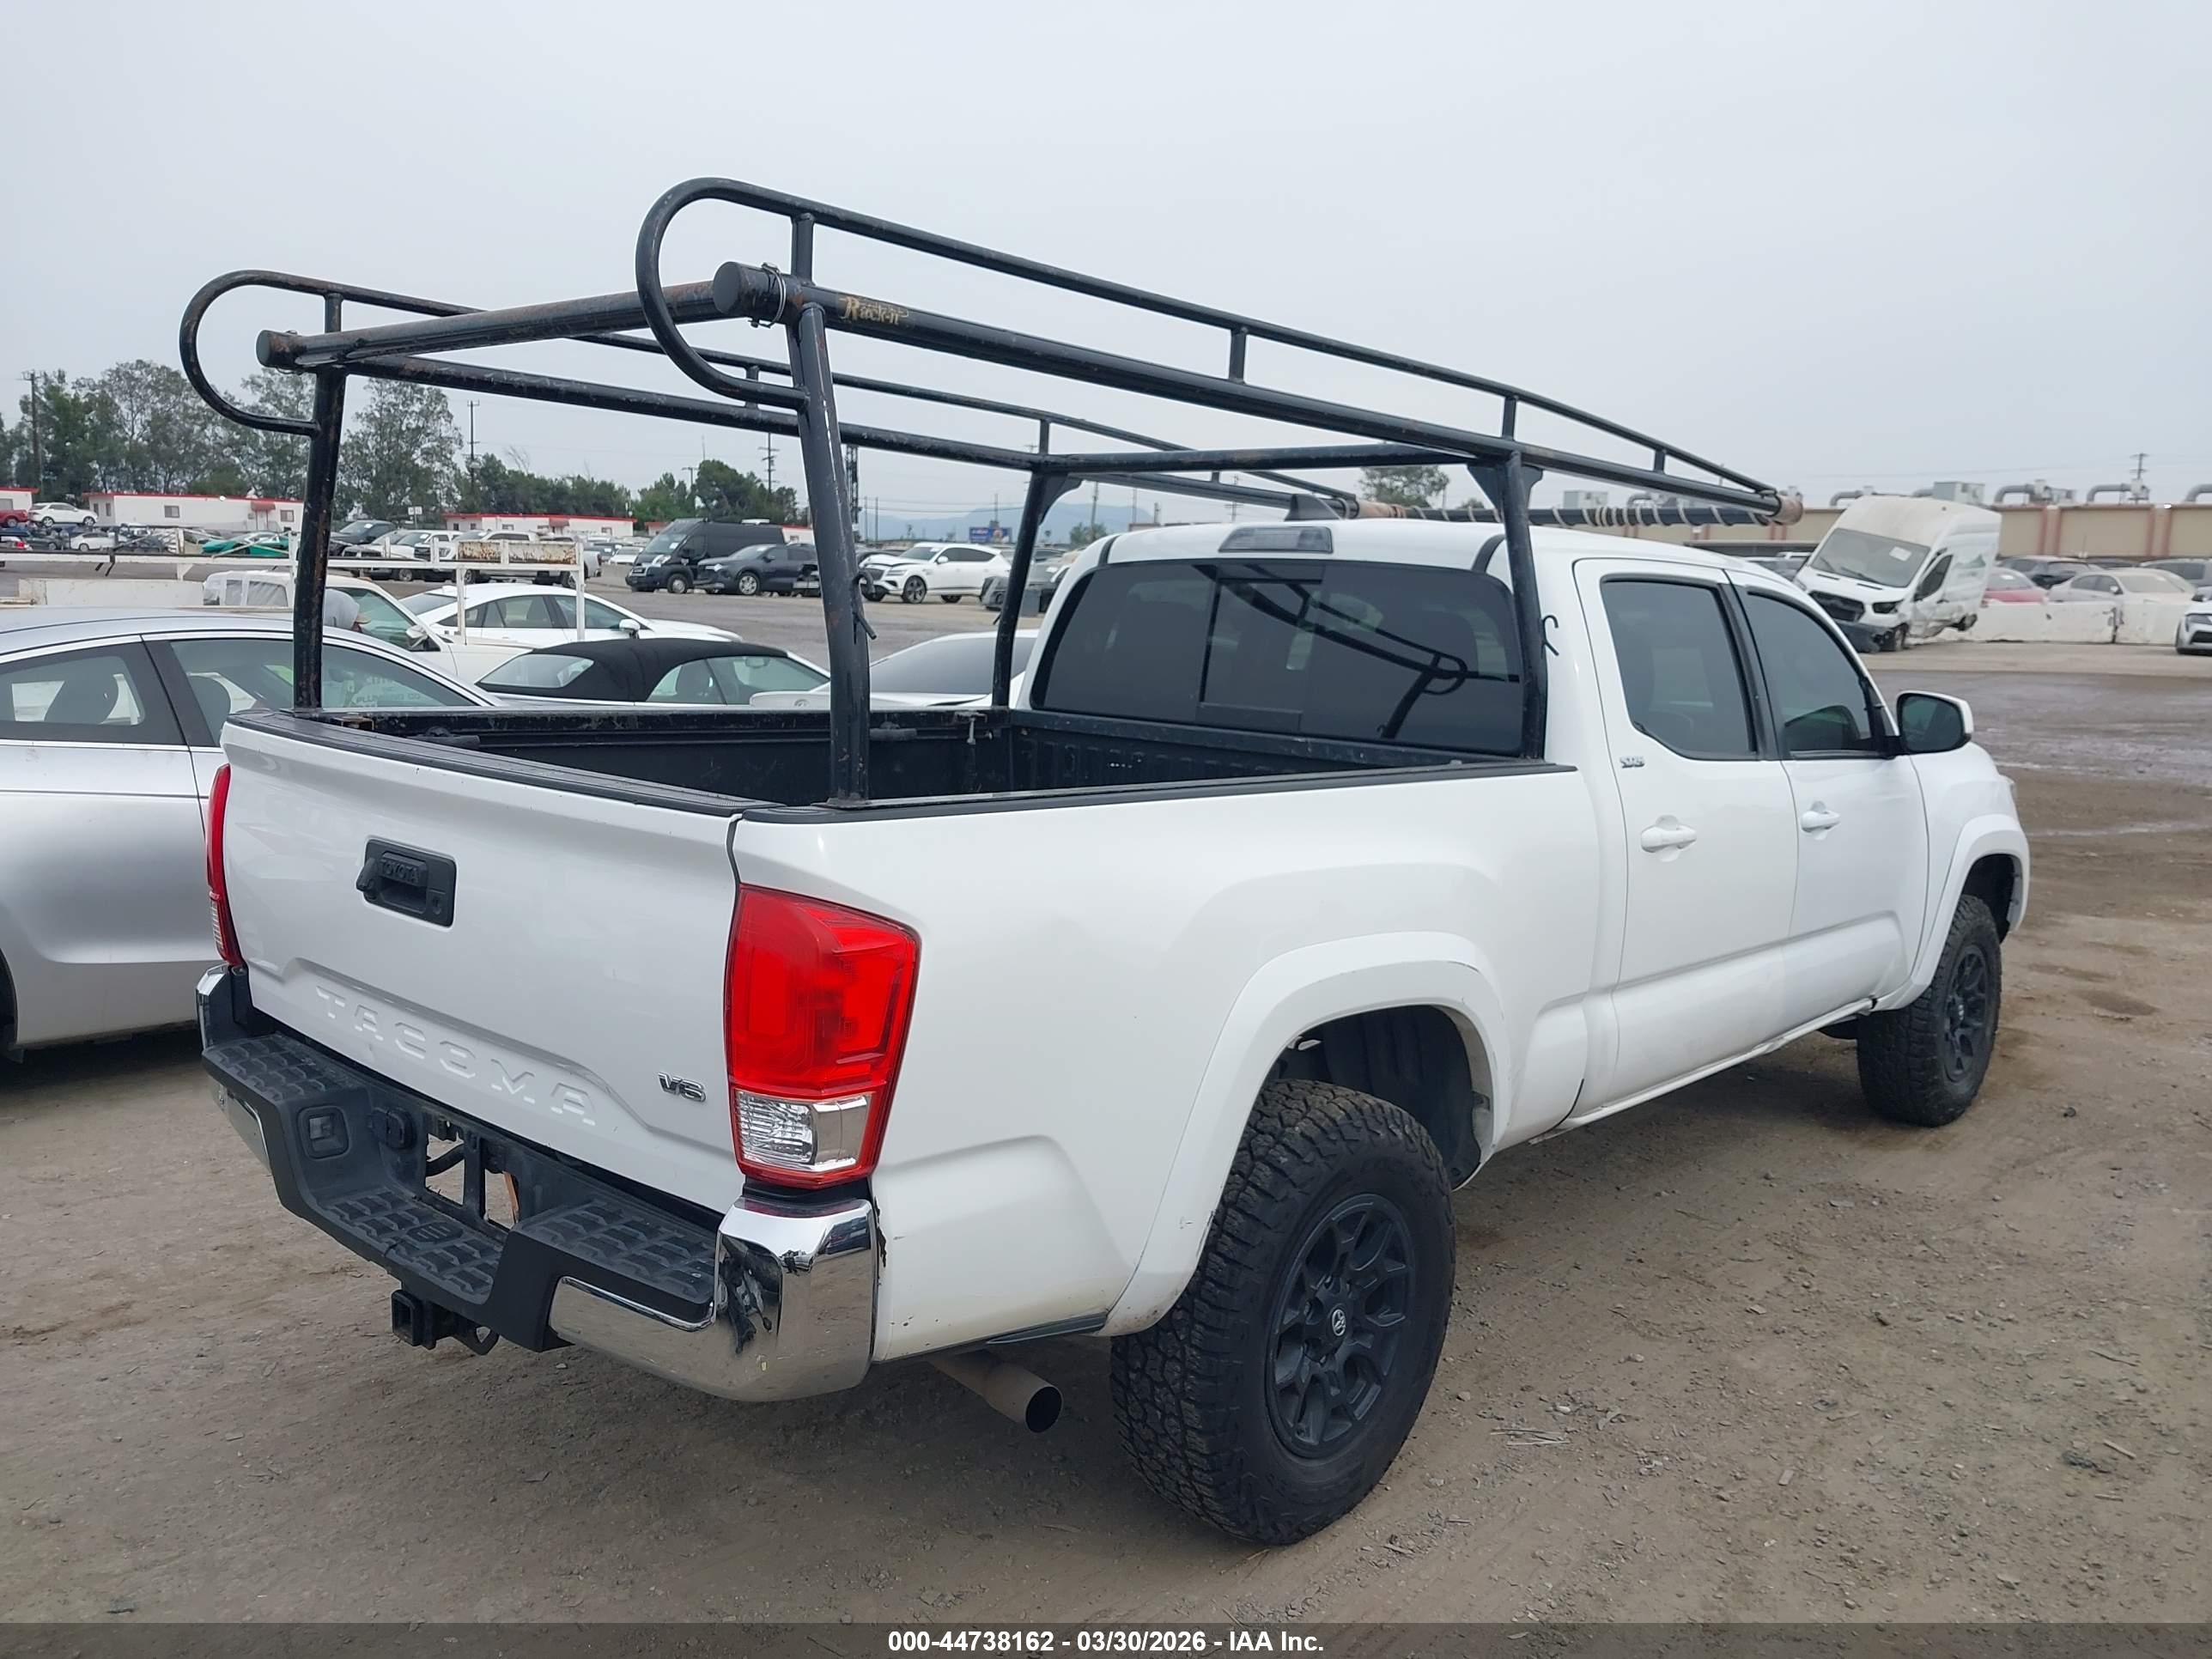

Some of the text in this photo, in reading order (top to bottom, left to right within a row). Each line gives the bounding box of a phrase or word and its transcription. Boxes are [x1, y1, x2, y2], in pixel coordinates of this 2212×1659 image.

[379, 859, 421, 884] TOYOTA
[315, 985, 596, 1126] TACOMA
[658, 1072, 707, 1103] V6
